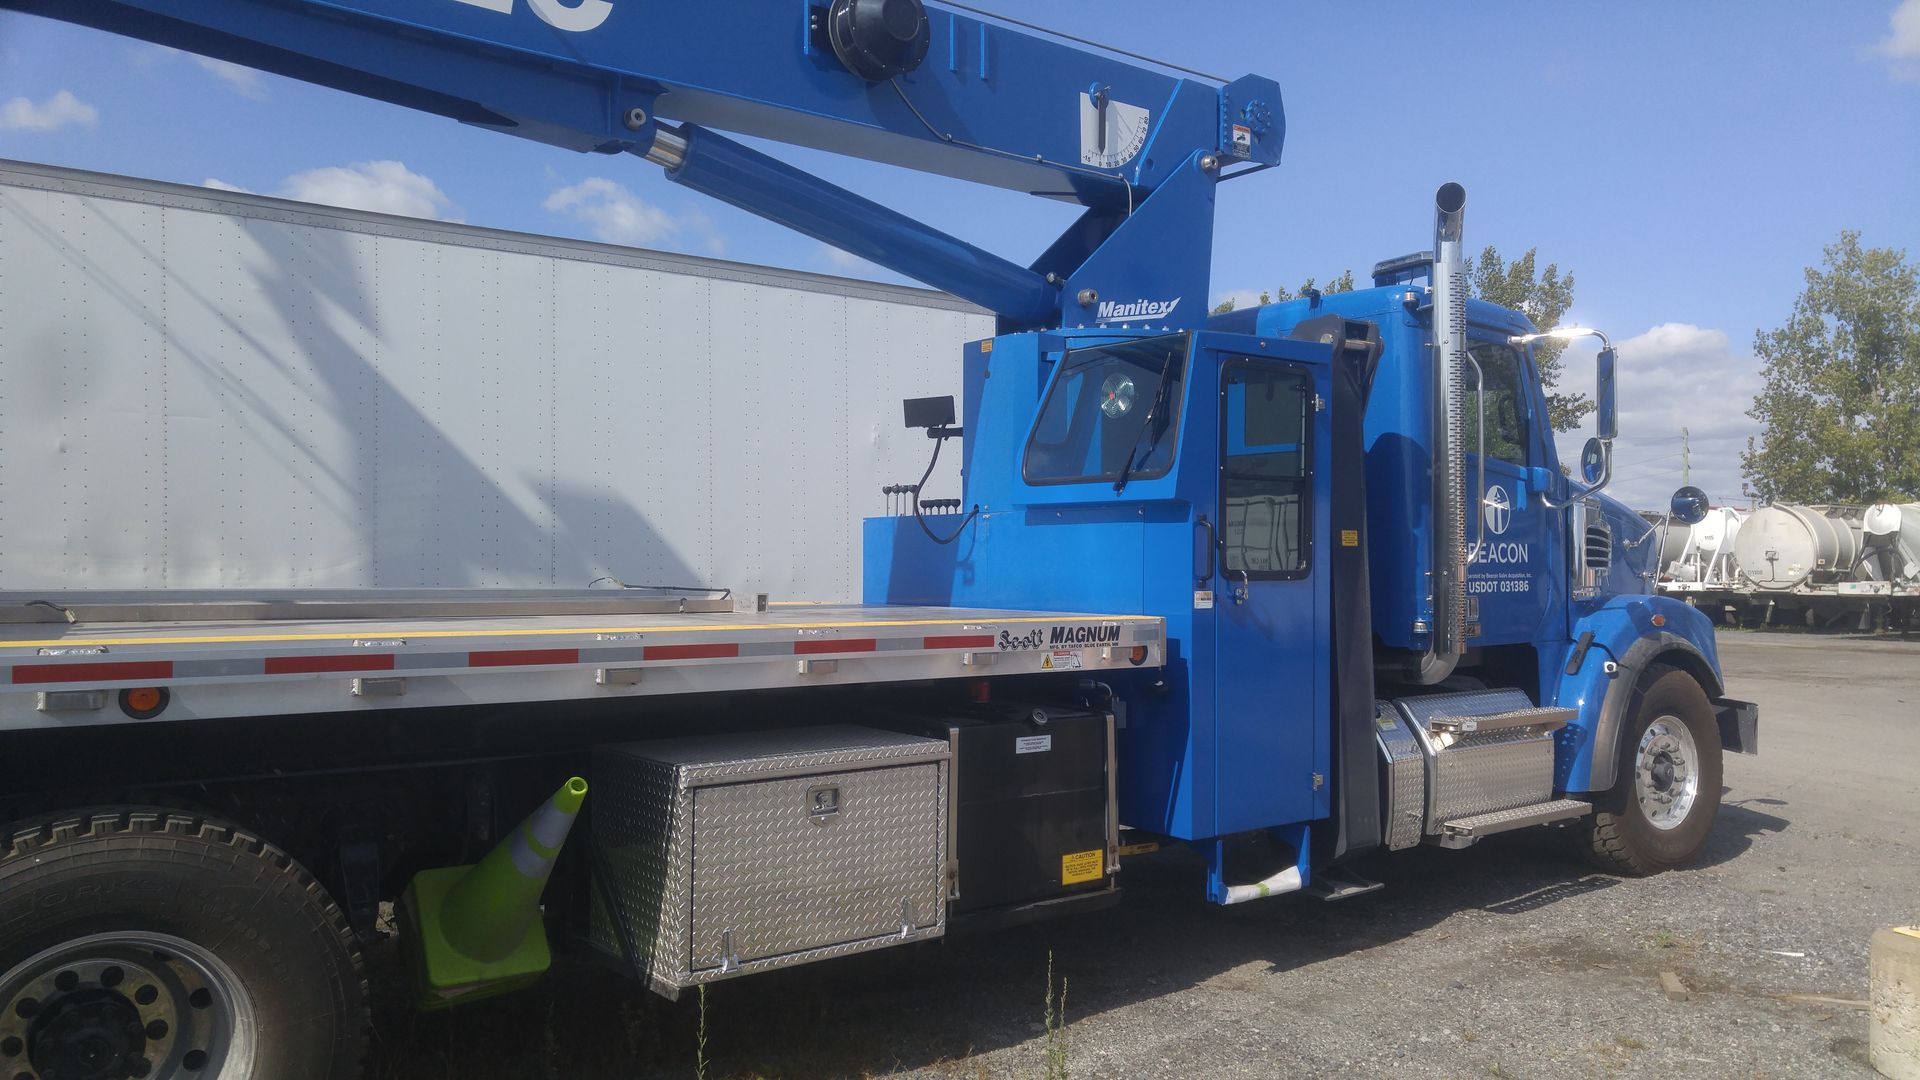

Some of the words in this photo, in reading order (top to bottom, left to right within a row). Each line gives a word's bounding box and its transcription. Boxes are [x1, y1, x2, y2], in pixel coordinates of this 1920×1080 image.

[1144, 117, 1148, 125] 80
[1097, 299, 1169, 318] Manitex
[1468, 543, 1529, 563] BEACON
[1469, 581, 1498, 593] USDOT
[1500, 581, 1529, 592] 031386
[998, 629, 1044, 651] Scott
[1050, 626, 1120, 643] MAGNUM
